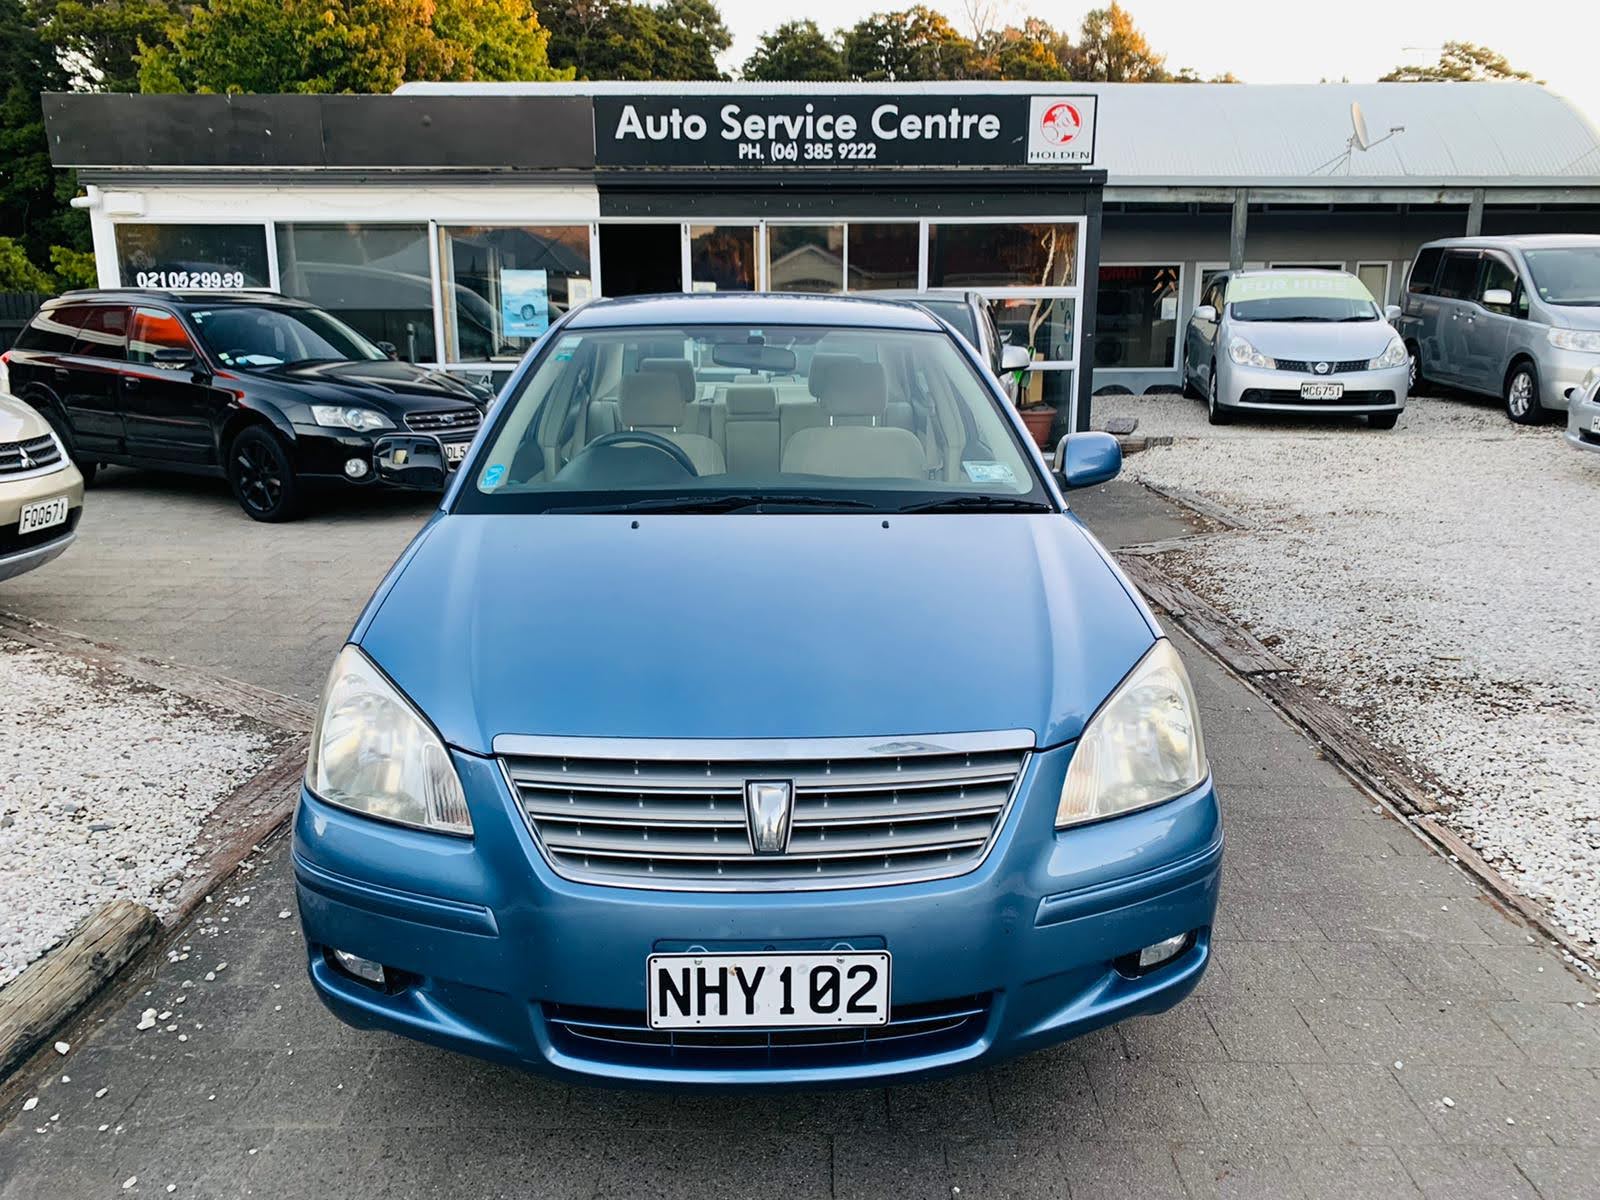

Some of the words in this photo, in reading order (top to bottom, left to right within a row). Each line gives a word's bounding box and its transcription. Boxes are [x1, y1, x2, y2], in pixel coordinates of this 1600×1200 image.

[614, 105, 707, 140] Auto
[720, 103, 858, 140] Service
[871, 104, 1001, 140] Centre
[738, 143, 765, 159] PH.
[770, 142, 798, 161] (06)
[803, 143, 833, 159] 385
[838, 143, 877, 159] 9222
[1030, 151, 1090, 159] HOLDEN
[1302, 385, 1341, 397] MCG751
[658, 965, 878, 1016] NHY102
